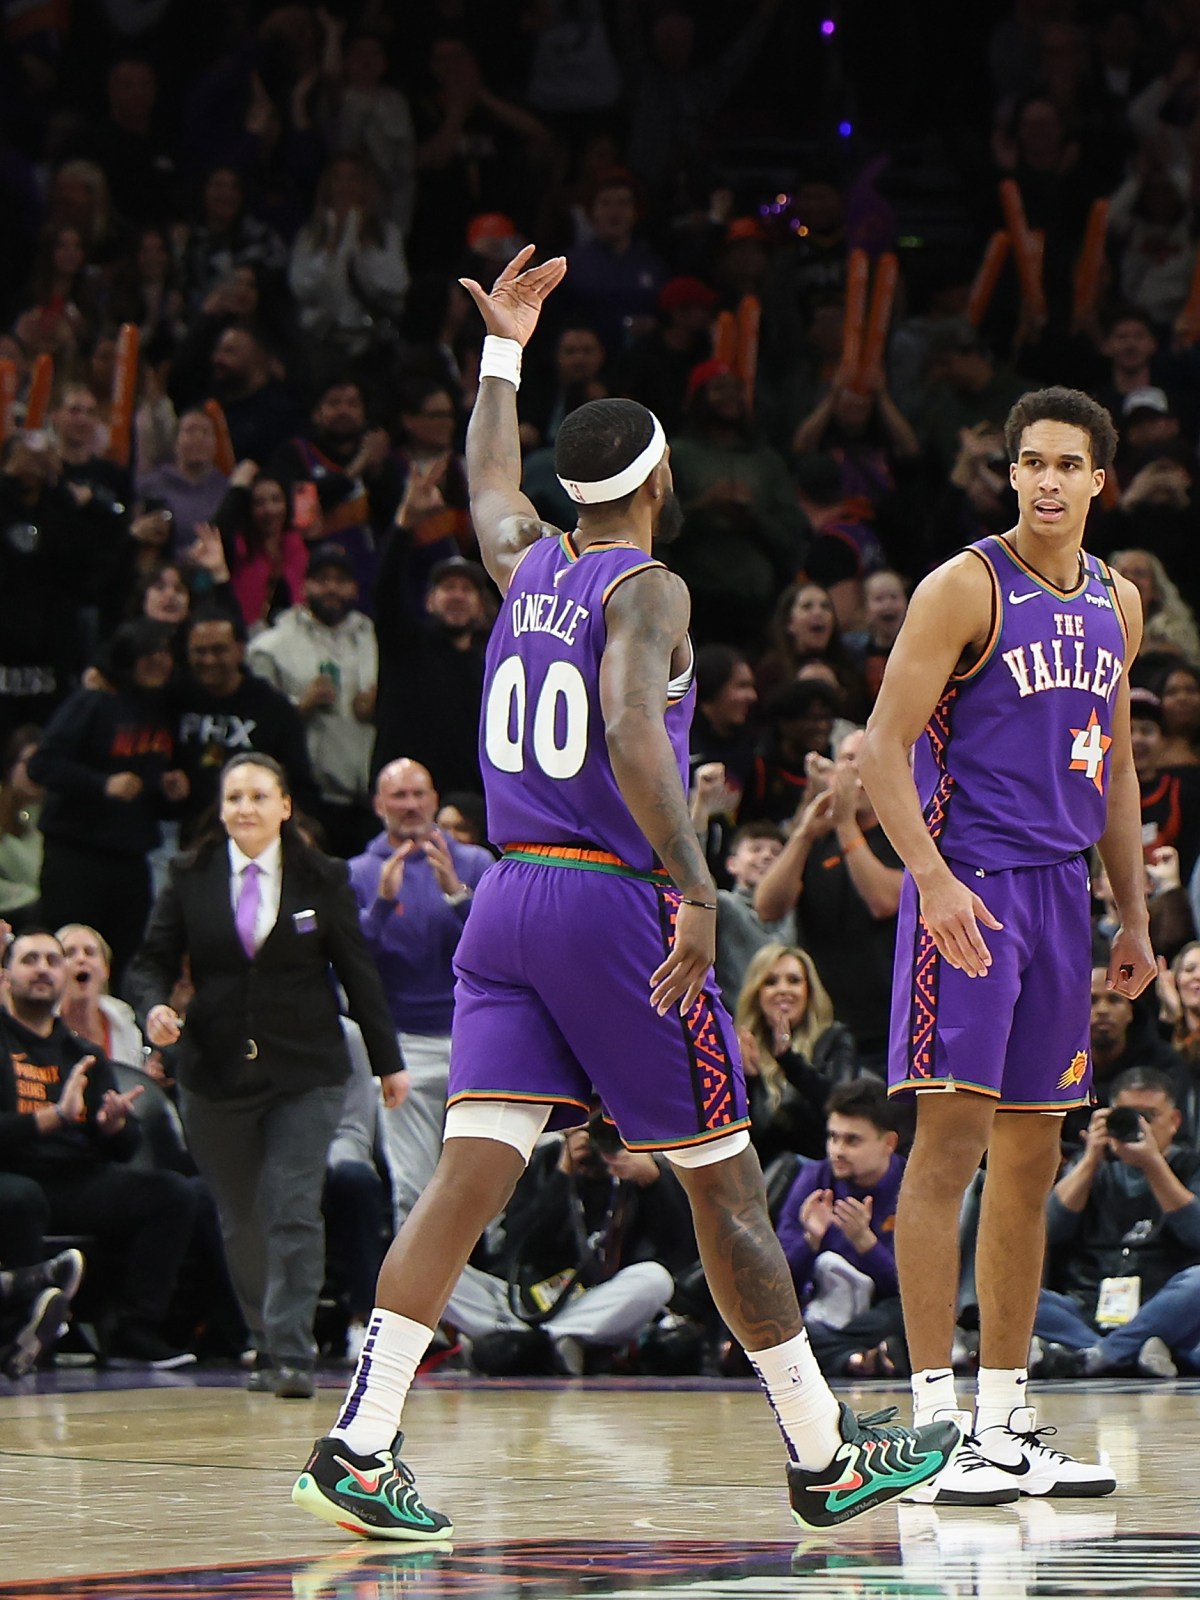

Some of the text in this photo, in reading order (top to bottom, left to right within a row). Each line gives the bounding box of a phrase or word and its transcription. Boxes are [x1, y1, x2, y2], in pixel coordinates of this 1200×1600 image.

[512, 592, 589, 646] O'NEALE
[1053, 613, 1085, 637] THE
[178, 712, 257, 750] PHX
[485, 655, 589, 779] 00
[1071, 725, 1103, 778] 4
